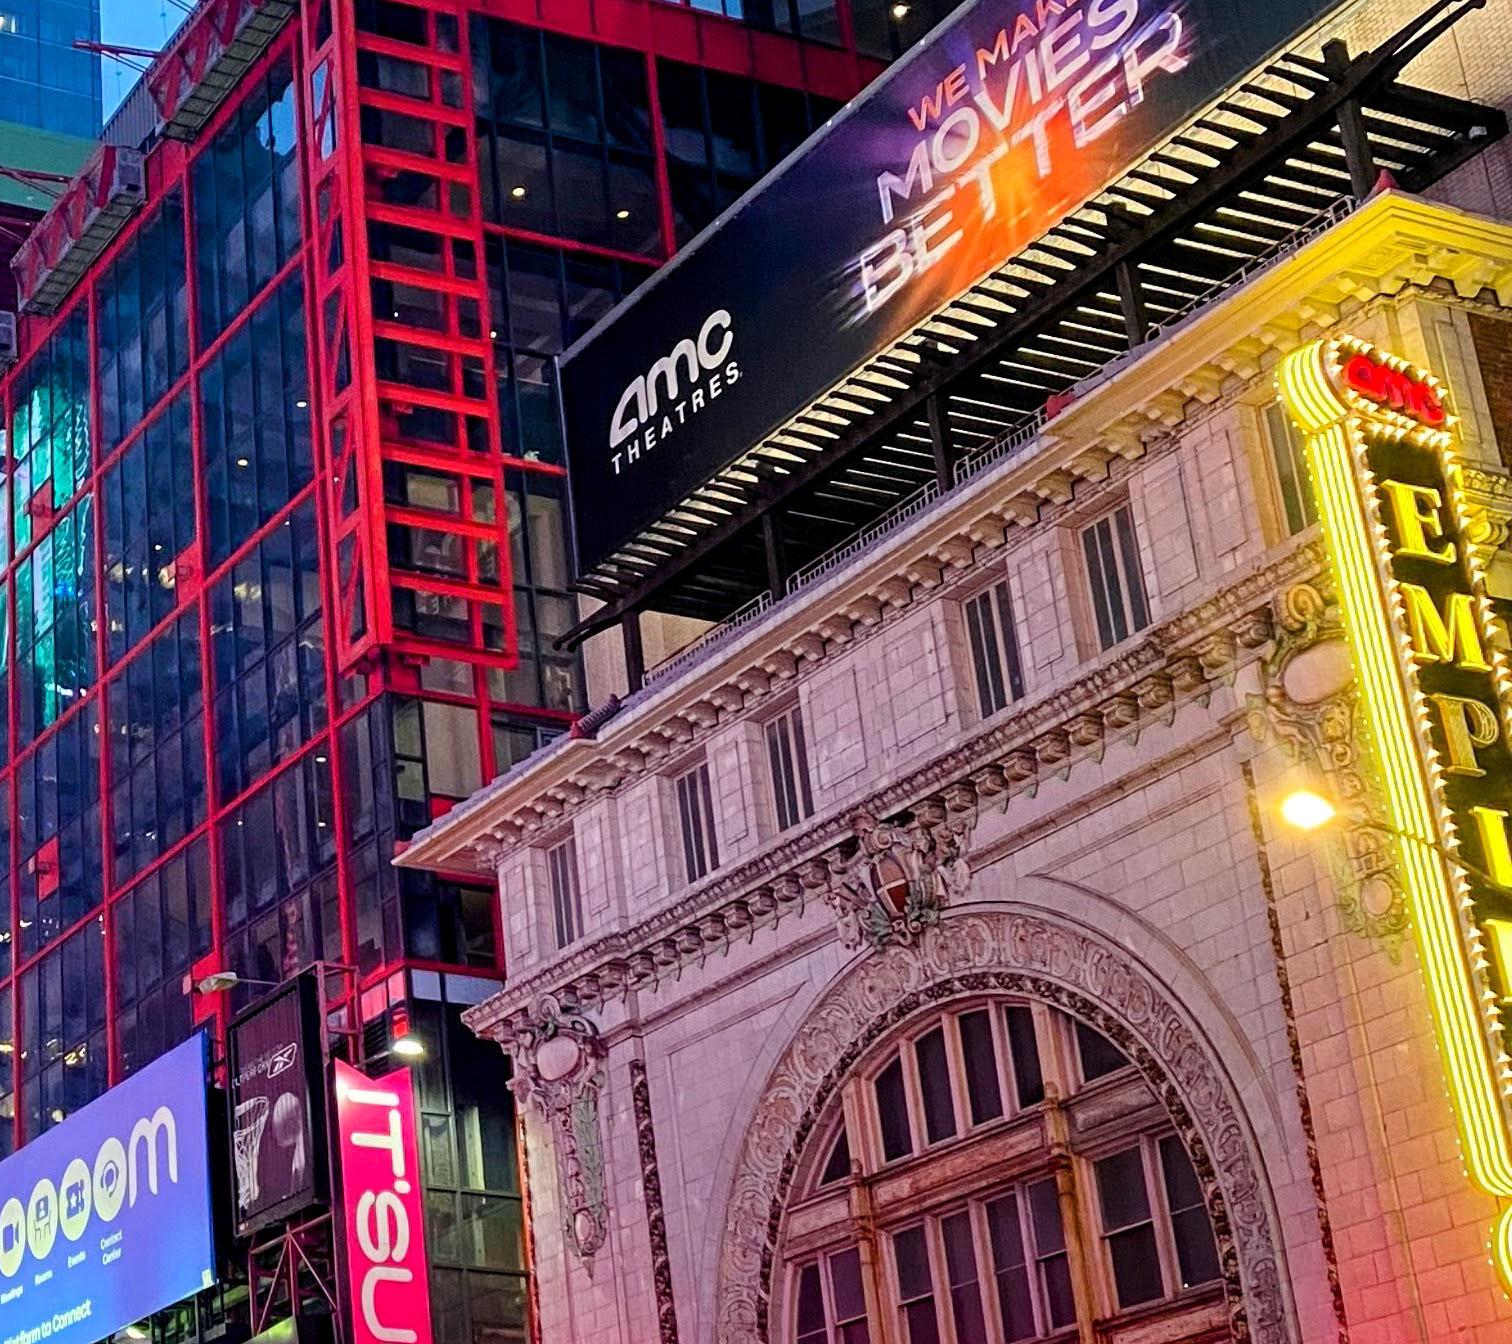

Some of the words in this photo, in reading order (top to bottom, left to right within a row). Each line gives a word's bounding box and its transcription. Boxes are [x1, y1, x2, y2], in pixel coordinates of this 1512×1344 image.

[908, 63, 970, 132] WE
[858, 11, 1189, 313] BETTER
[611, 361, 739, 474] THEATRES
[41, 1318, 51, 1339] to
[51, 1299, 92, 1332] Connect
